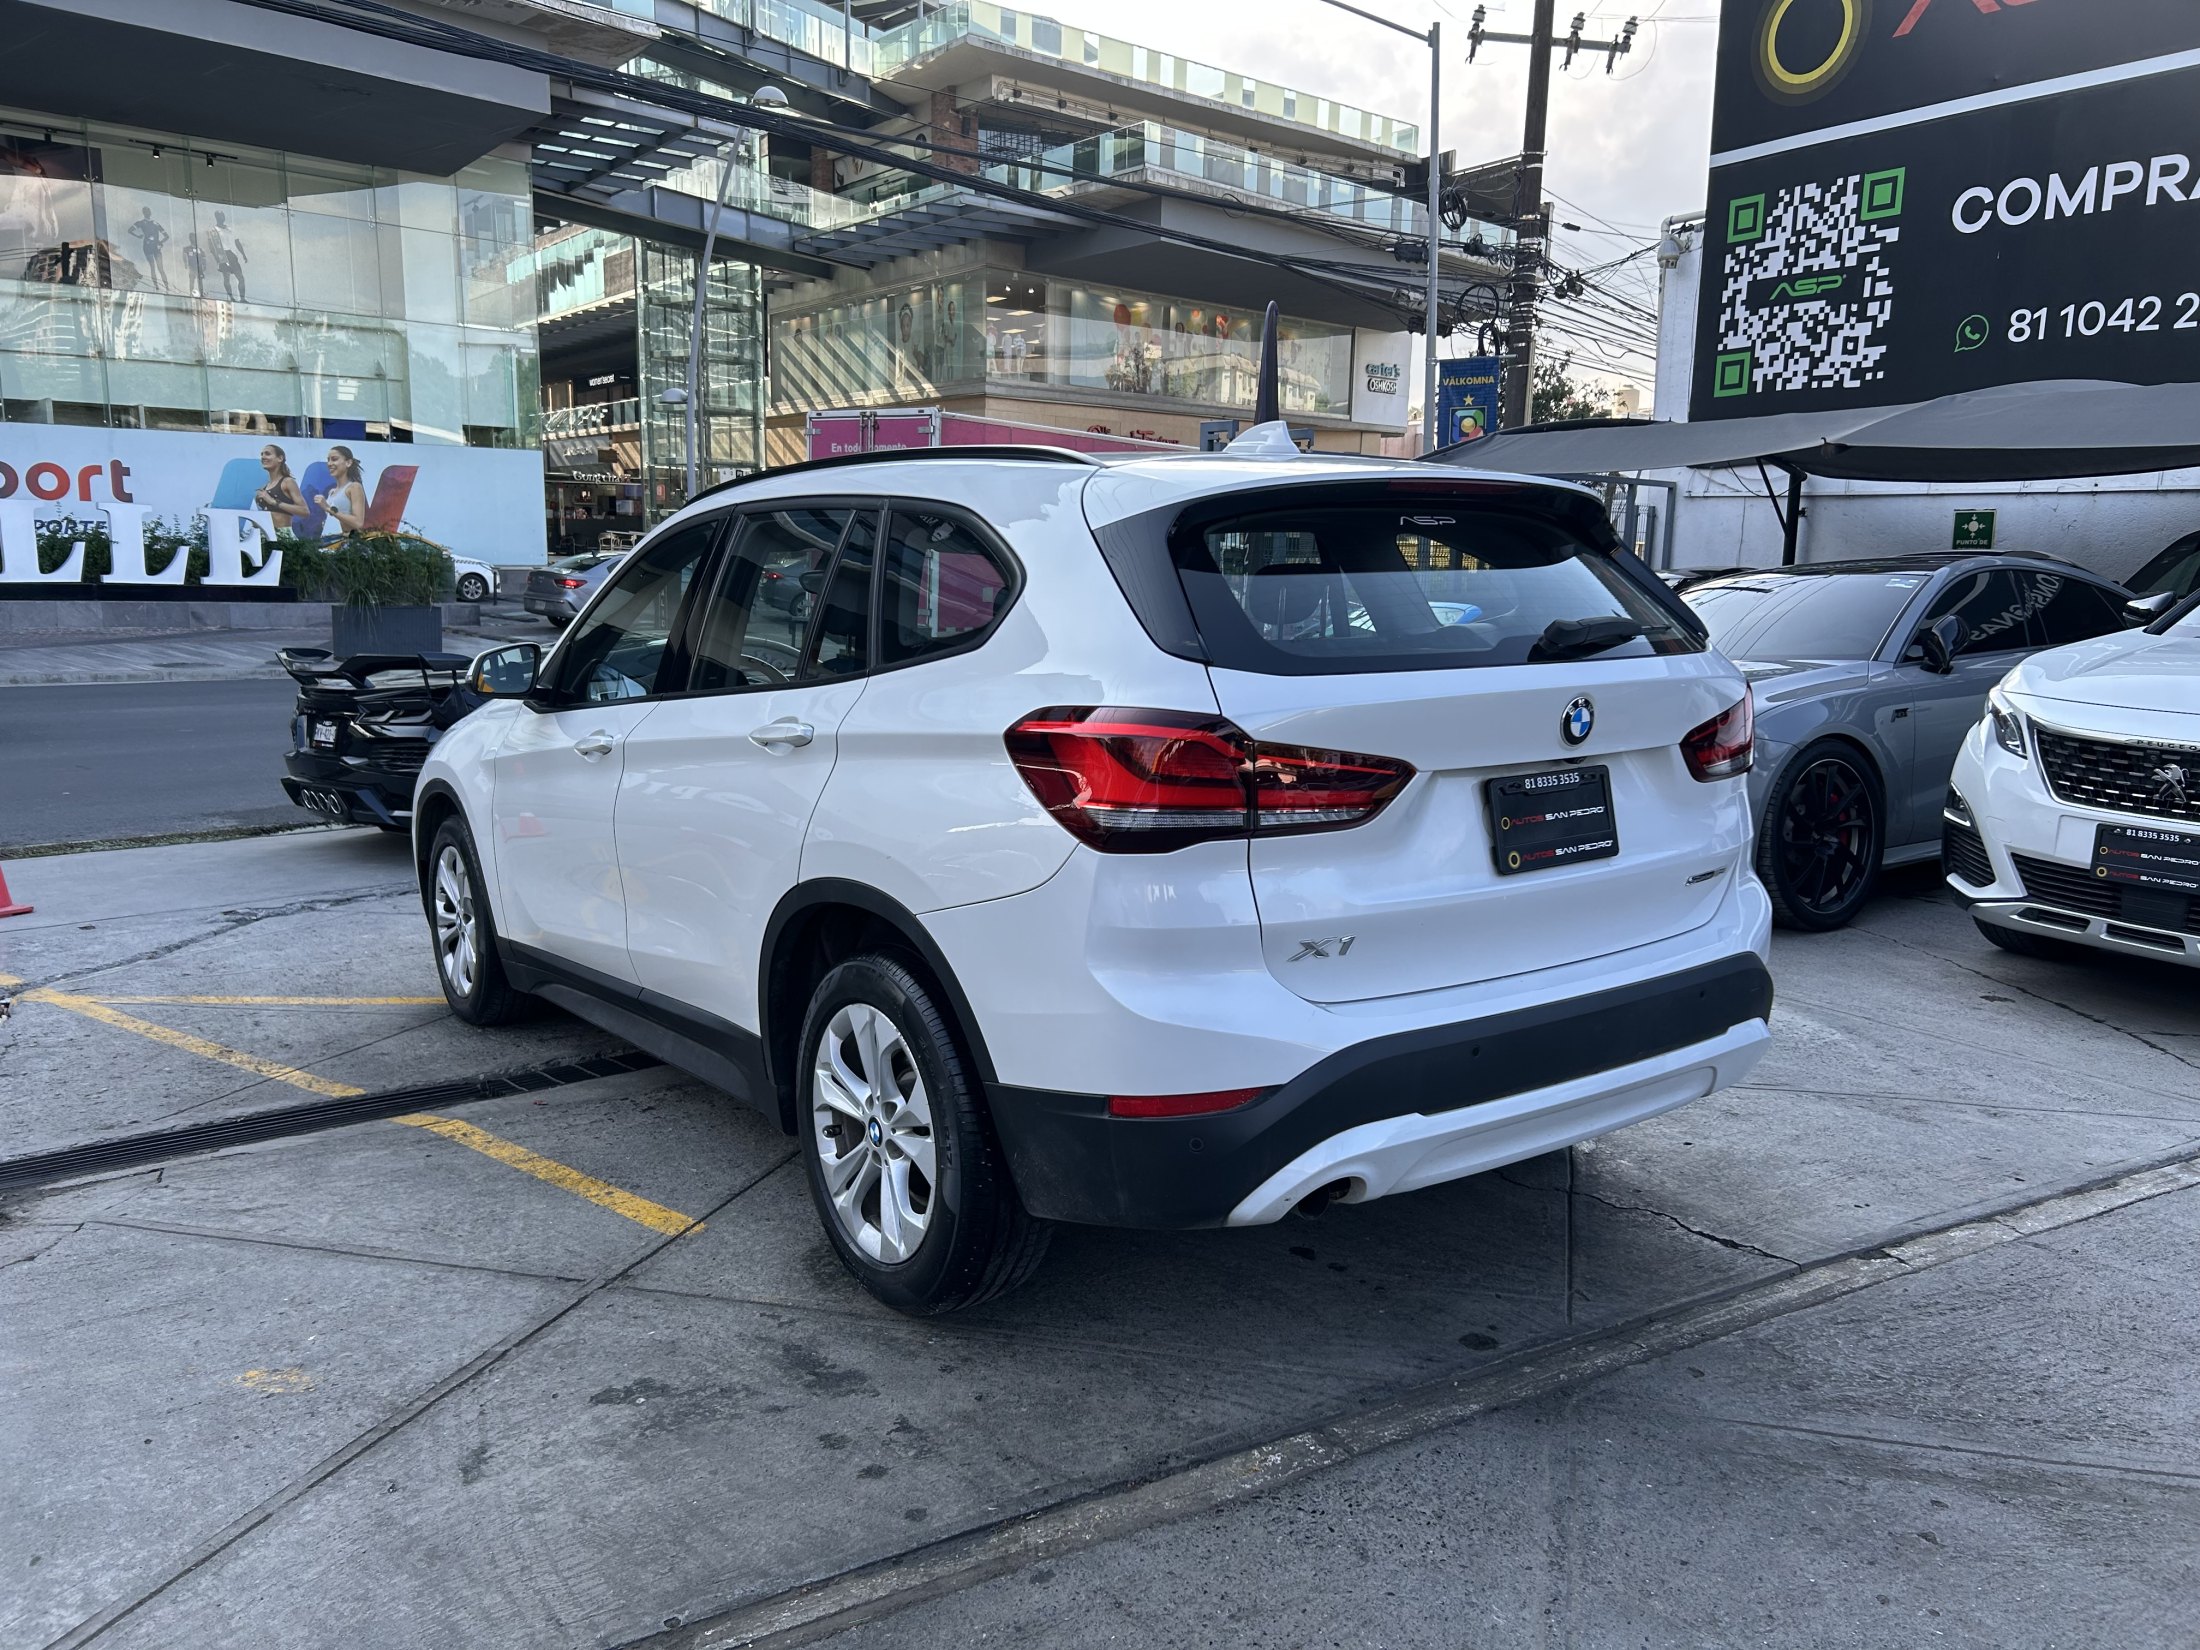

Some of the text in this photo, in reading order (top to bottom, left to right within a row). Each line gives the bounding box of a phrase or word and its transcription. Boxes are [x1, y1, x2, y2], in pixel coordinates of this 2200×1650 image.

[2007, 307, 2049, 343] 81
[2059, 296, 2162, 338] 1042
[1443, 375, 1495, 386] VÄLKOMNA
[831, 443, 842, 453] En
[1524, 772, 1580, 789] 81 8335 3535
[1510, 806, 1605, 825] AUTOS SAN PEDRO
[2126, 828, 2180, 842] 81 8335 3535
[1521, 840, 1613, 861] AUTOS SAN PEDRO
[2140, 853, 2162, 861] SAN
[2163, 856, 2199, 866] PEDRO
[2140, 875, 2161, 883] SAN
[2162, 878, 2197, 888] PEDRO
[1286, 935, 1357, 962] X1
